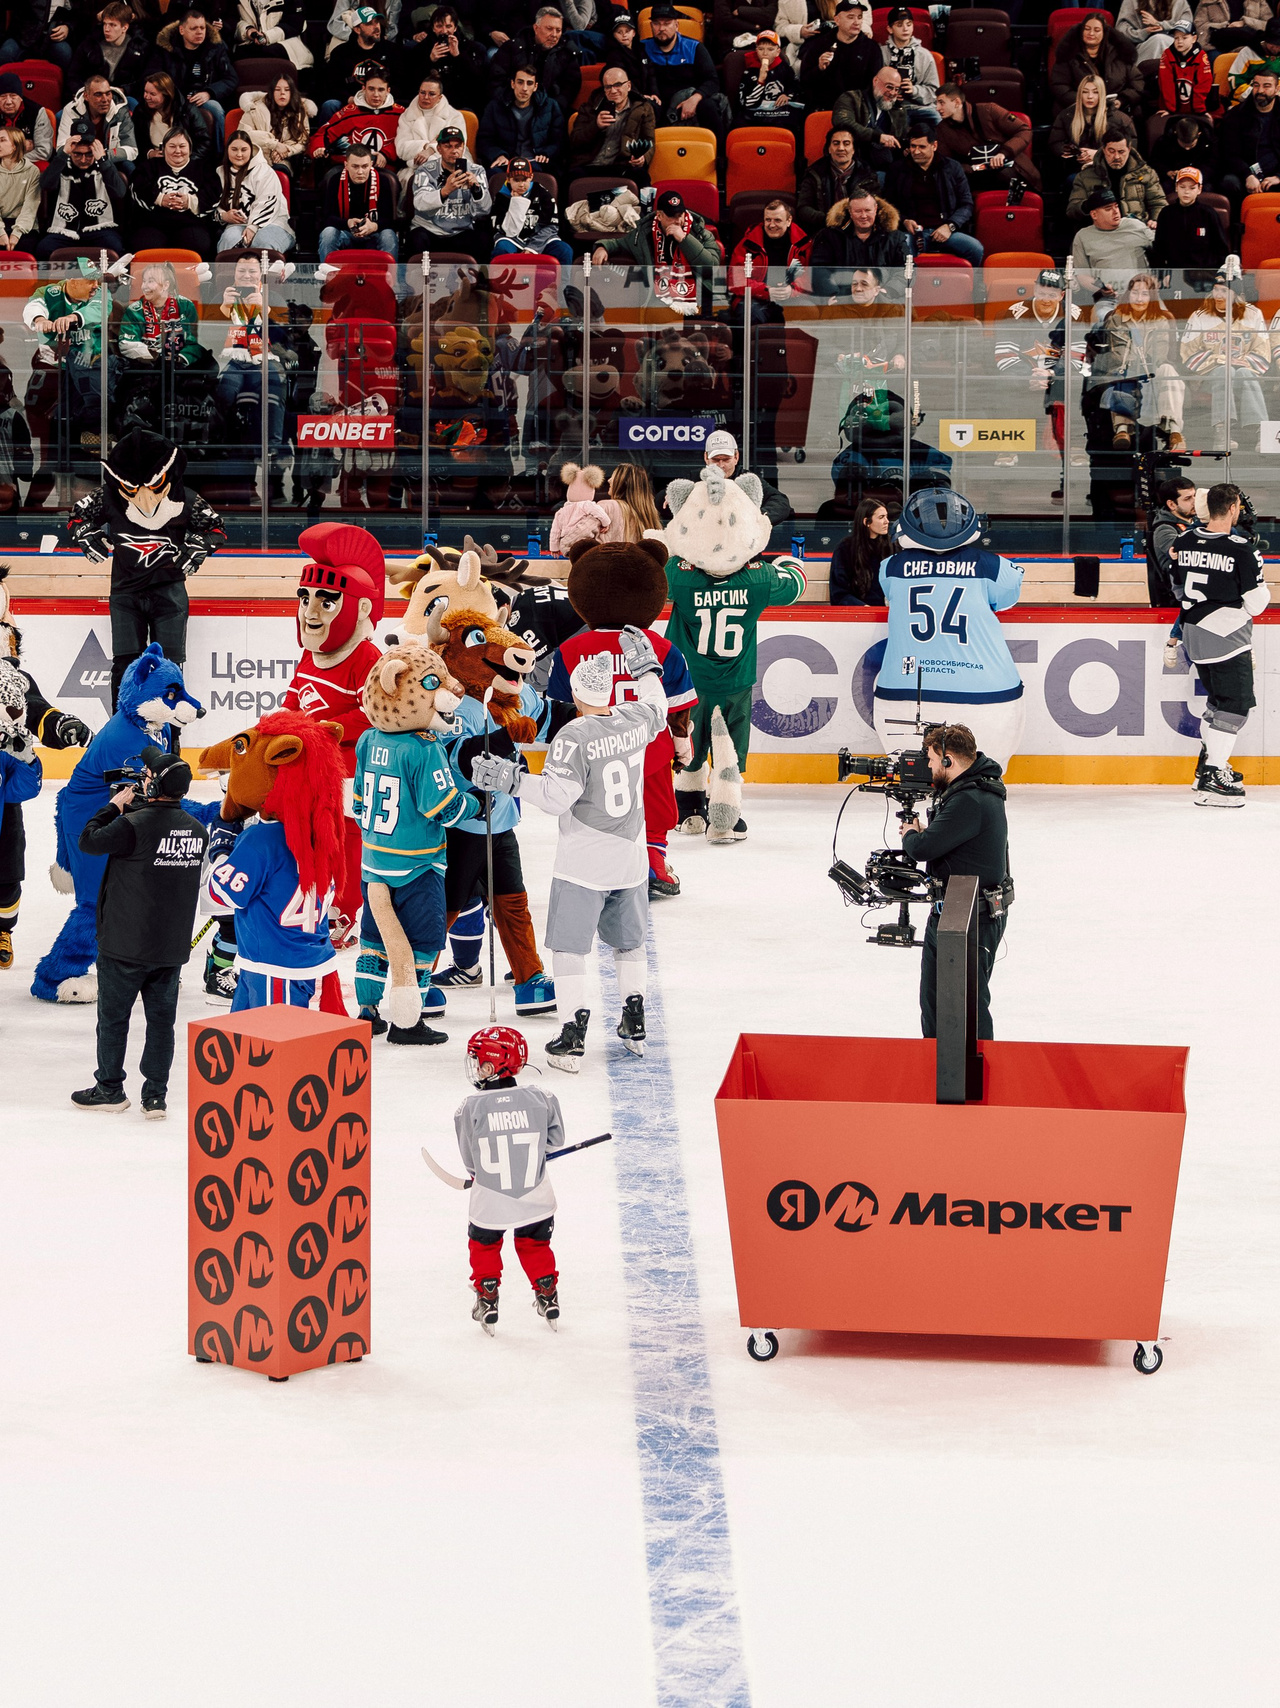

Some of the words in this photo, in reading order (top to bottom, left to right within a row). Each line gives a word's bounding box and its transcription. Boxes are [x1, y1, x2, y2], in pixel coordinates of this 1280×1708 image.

[300, 422, 392, 441] FONBET
[977, 430, 1025, 441] БАНК
[1253, 550, 1264, 568] 5
[694, 589, 749, 607] БАРСИК
[1181, 571, 1209, 610] 5
[909, 583, 969, 647] 54
[695, 608, 747, 658] 16
[211, 652, 300, 683] Цент
[919, 659, 984, 671] НОВОСИБИРСКАЯ
[920, 667, 955, 675] ОБЛАСТЬ
[371, 746, 389, 766] LEO
[552, 738, 579, 763] 87
[432, 767, 455, 791] 93
[545, 762, 573, 777] FONBET
[602, 749, 644, 818] 87
[361, 771, 400, 836] 93
[156, 838, 178, 853] ALL
[179, 837, 203, 853] STAR
[153, 858, 190, 868] Ekaterinburg
[215, 864, 249, 893] 46
[487, 1110, 530, 1132] MIRON
[478, 1132, 541, 1190] 47
[889, 1190, 1132, 1235] Маркет
